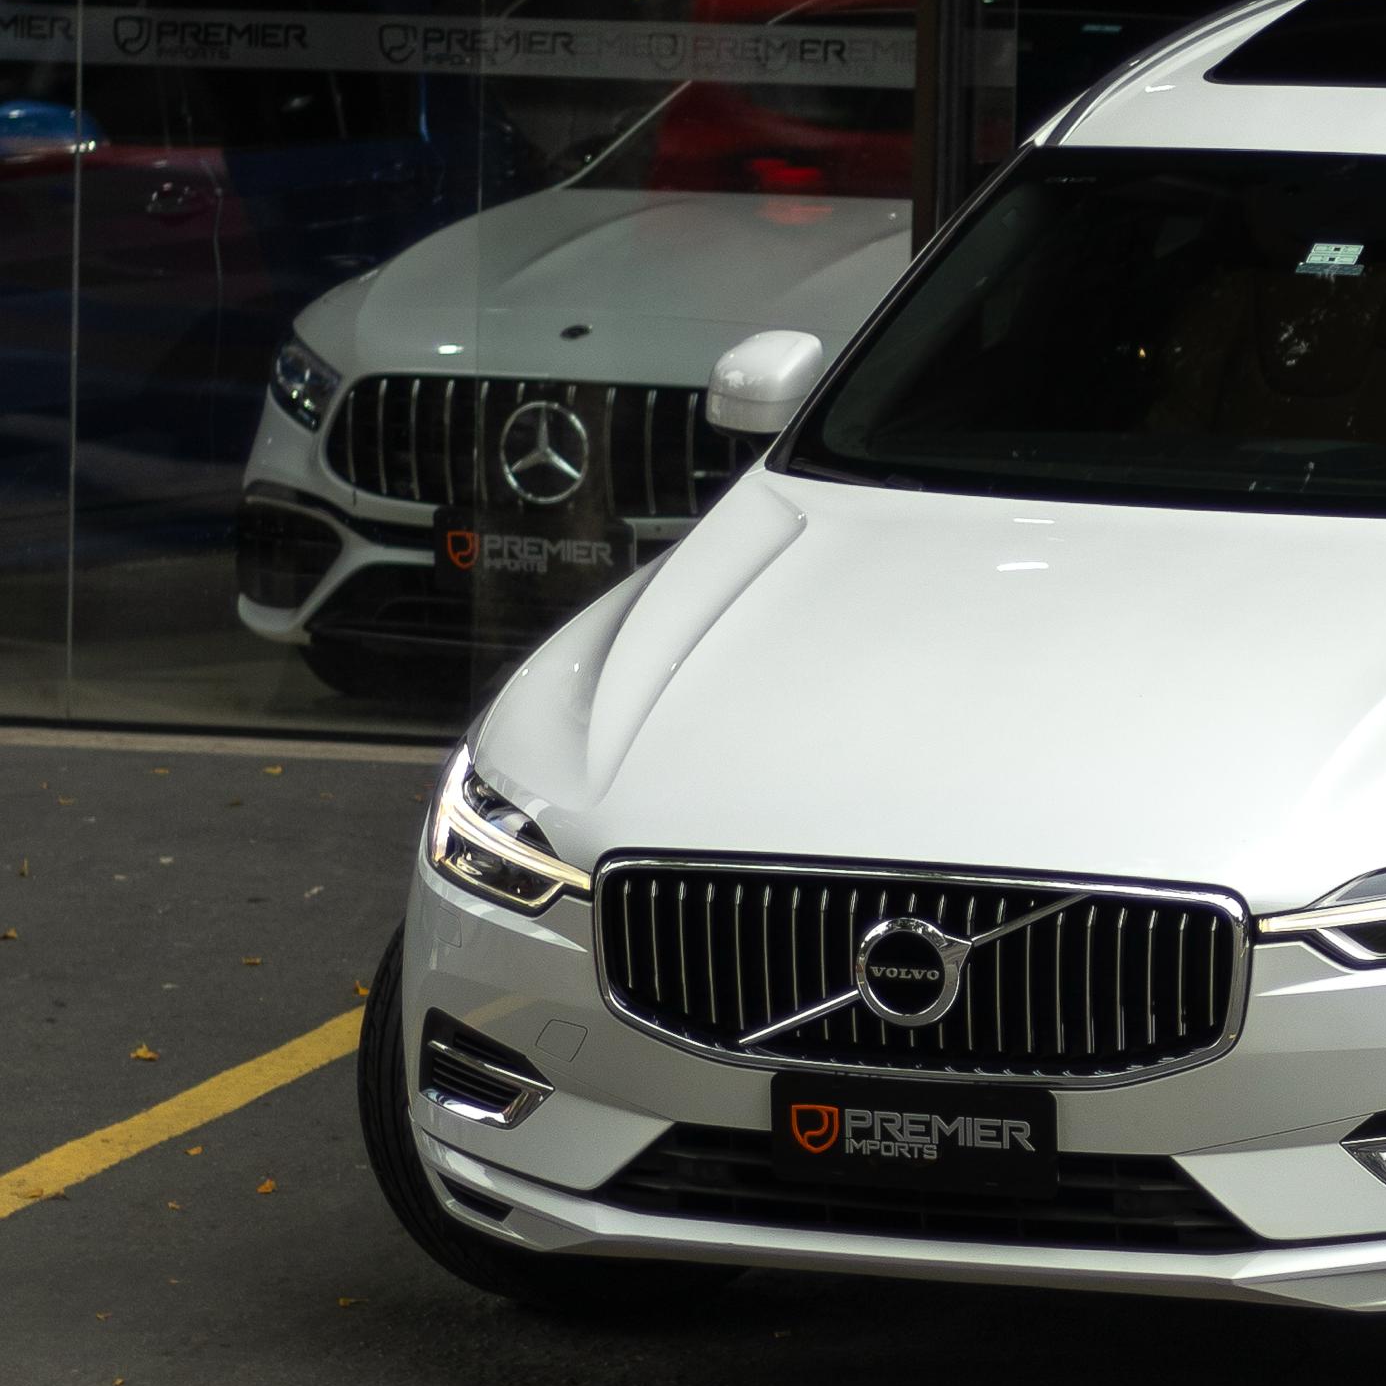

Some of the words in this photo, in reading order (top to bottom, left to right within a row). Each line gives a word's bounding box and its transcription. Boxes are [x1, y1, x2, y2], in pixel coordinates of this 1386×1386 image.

[0, 14, 75, 41] MIER
[156, 20, 308, 50] PREMIER
[422, 27, 576, 57] PREMIER
[483, 534, 615, 566] PREMIER
[870, 966, 940, 981] VOLVO
[844, 1108, 1036, 1152] PREMIER
[844, 1138, 938, 1160] IMPORTS
